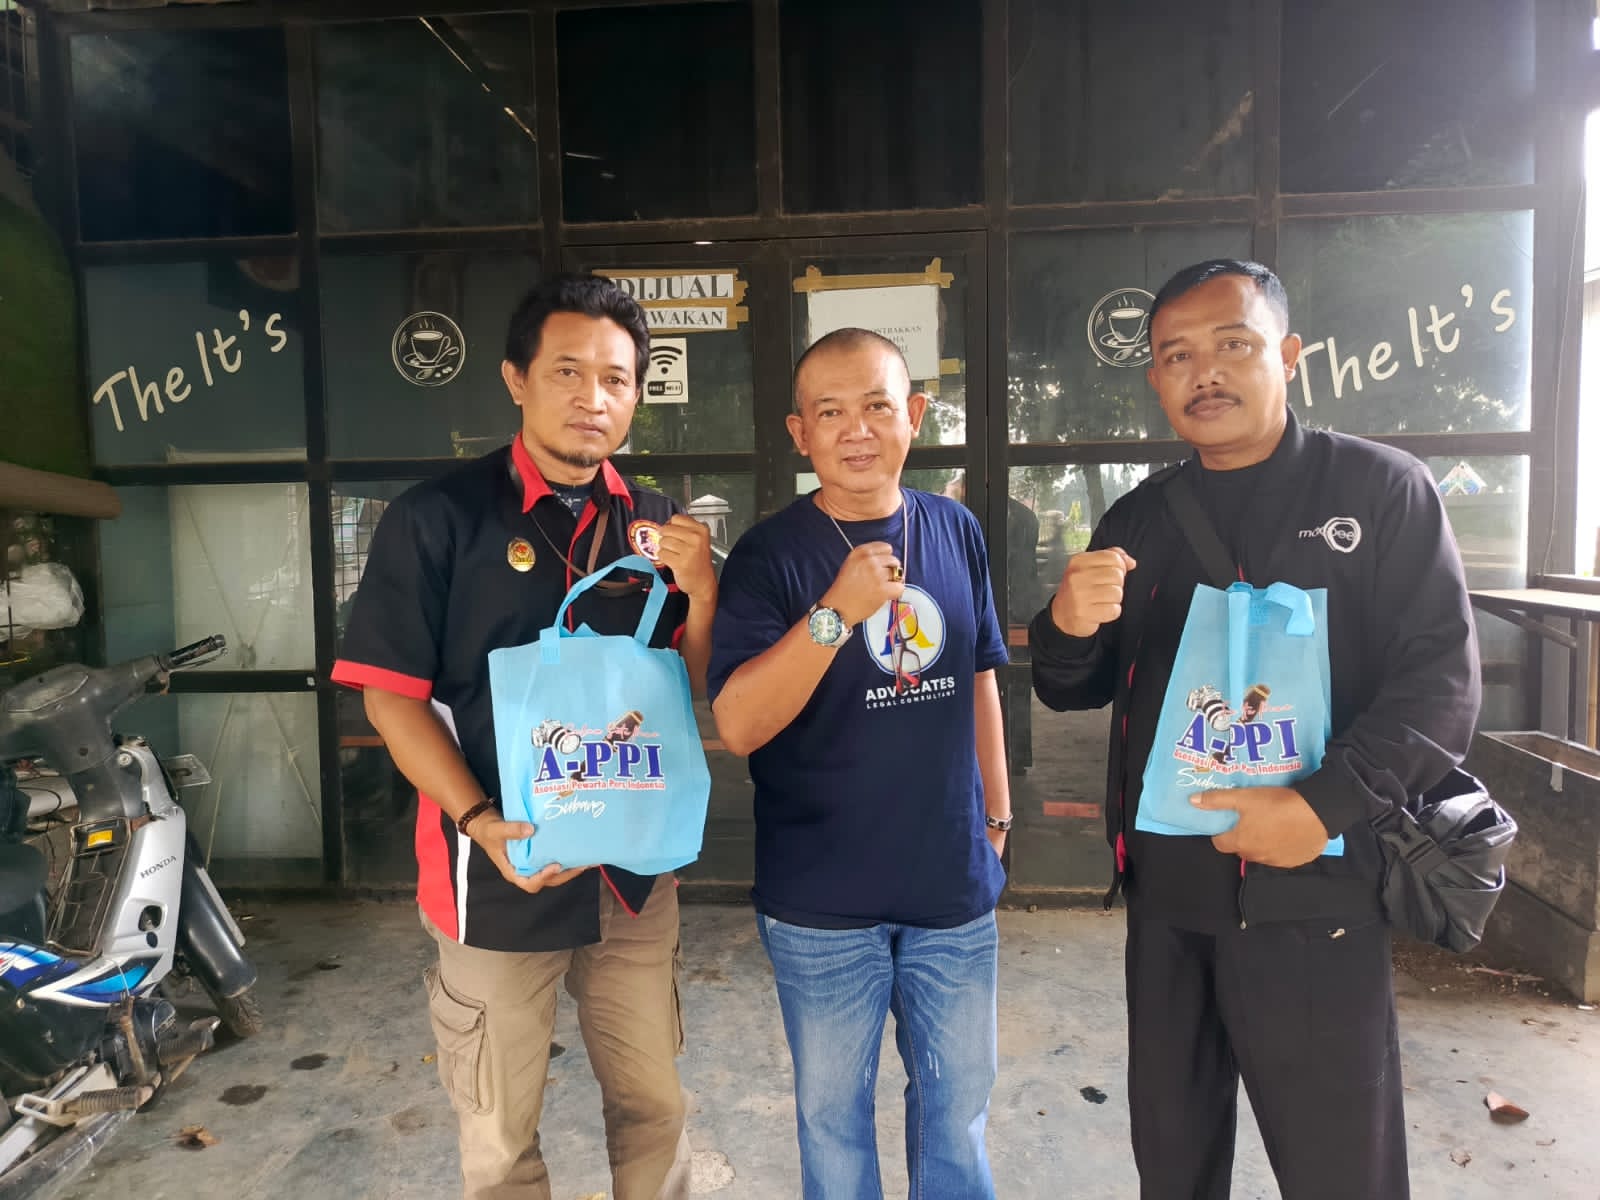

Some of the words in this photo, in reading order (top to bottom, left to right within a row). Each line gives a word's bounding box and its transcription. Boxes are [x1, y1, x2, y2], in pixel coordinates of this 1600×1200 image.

[615, 275, 729, 300] DIJUAL
[649, 310, 723, 325] WAKAN
[1296, 337, 1400, 406] The
[1408, 283, 1517, 368] It's
[92, 364, 192, 432] The
[194, 309, 288, 387] It's
[865, 676, 955, 702] ADVATES
[866, 700, 897, 709] LEGAL
[1175, 713, 1300, 762] A-PPI
[533, 741, 664, 783] A-PPI
[1258, 760, 1302, 774] Indonesia
[534, 782, 568, 794] Asosiasi
[572, 780, 607, 791] Pewarta
[628, 780, 665, 790] Indonesia
[140, 855, 177, 878] HONDA
